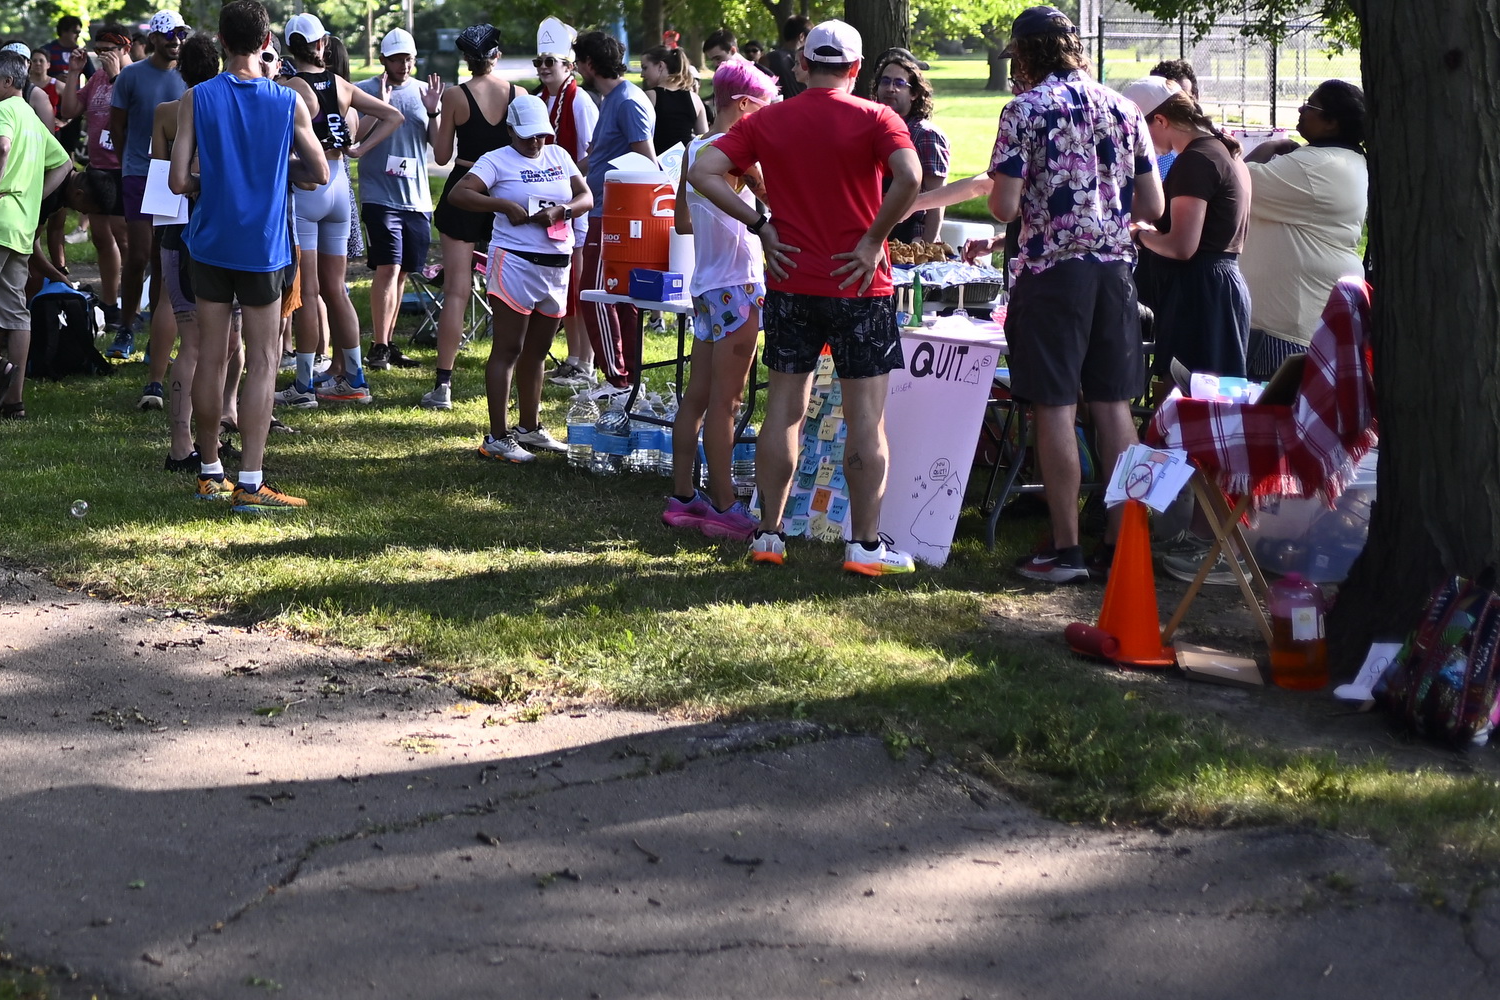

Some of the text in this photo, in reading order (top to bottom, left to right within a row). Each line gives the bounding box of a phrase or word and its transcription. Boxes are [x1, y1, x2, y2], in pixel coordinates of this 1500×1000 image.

[399, 159, 407, 171] 4
[909, 341, 970, 382] QUIT.
[891, 381, 913, 395] LOSER
